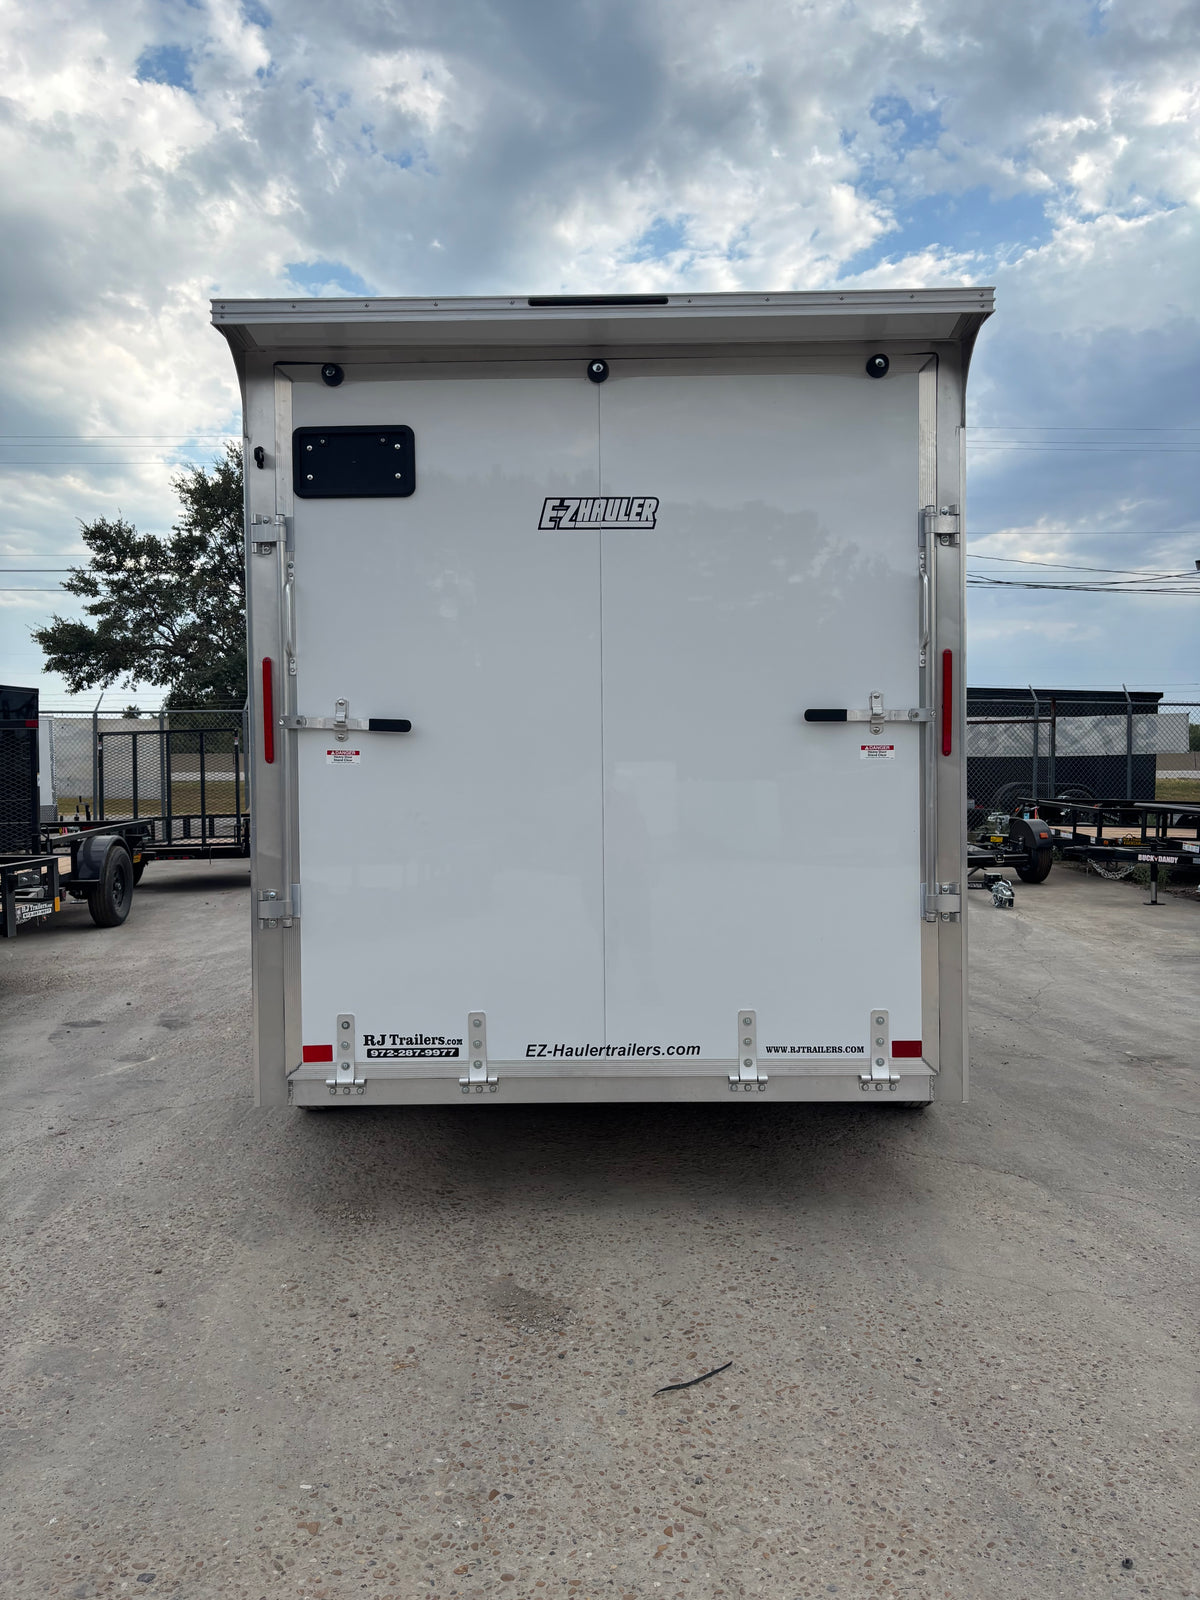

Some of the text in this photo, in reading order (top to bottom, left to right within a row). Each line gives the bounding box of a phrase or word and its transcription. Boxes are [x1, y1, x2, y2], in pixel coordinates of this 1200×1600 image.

[363, 1034, 386, 1046] RJ
[370, 1049, 456, 1057] 972-287-9977
[525, 1043, 701, 1057] EZ-Haulertrailers.com
[765, 1046, 865, 1054] WWW.RJTRAILERS.COM
